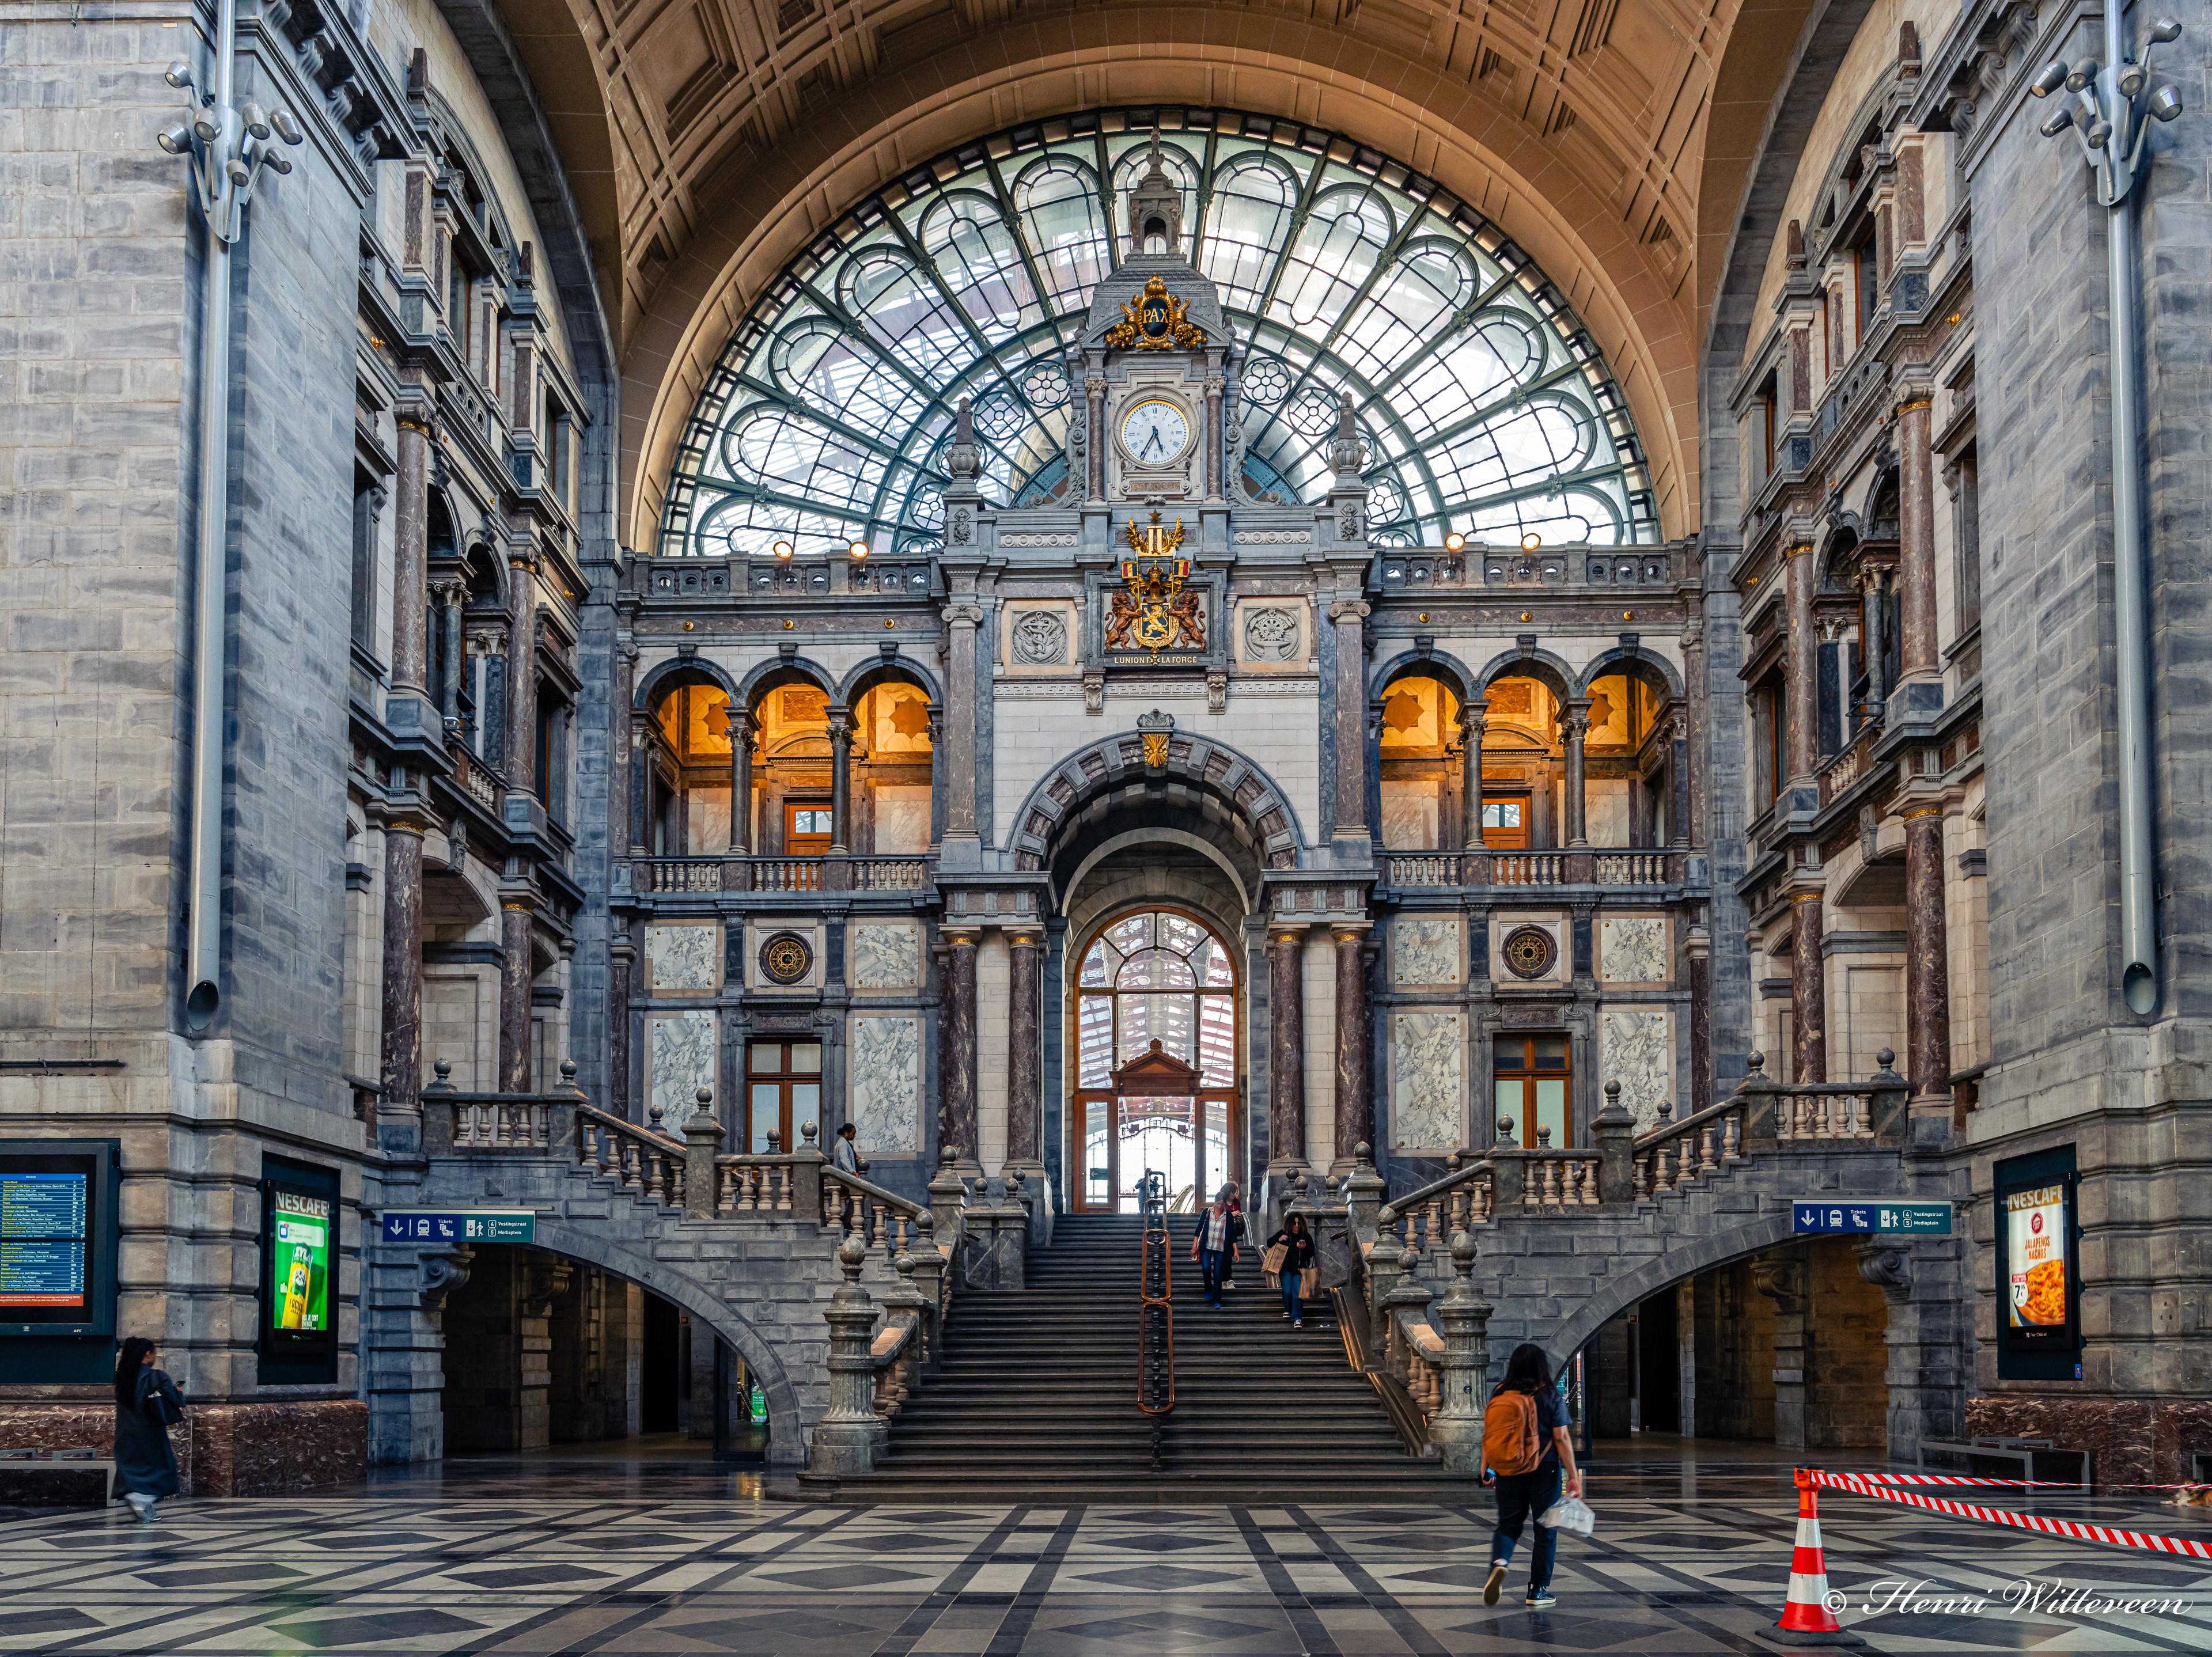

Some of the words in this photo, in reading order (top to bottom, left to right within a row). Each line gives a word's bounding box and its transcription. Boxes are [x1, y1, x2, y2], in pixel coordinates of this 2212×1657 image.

[1143, 308, 1169, 323] PAX
[2025, 1235, 2050, 1250] JALAPEÑOS
[2028, 1248, 2046, 1260] NACHOS
[2014, 1285, 2020, 1298] 7
[289, 1298, 303, 1313] FOCUS
